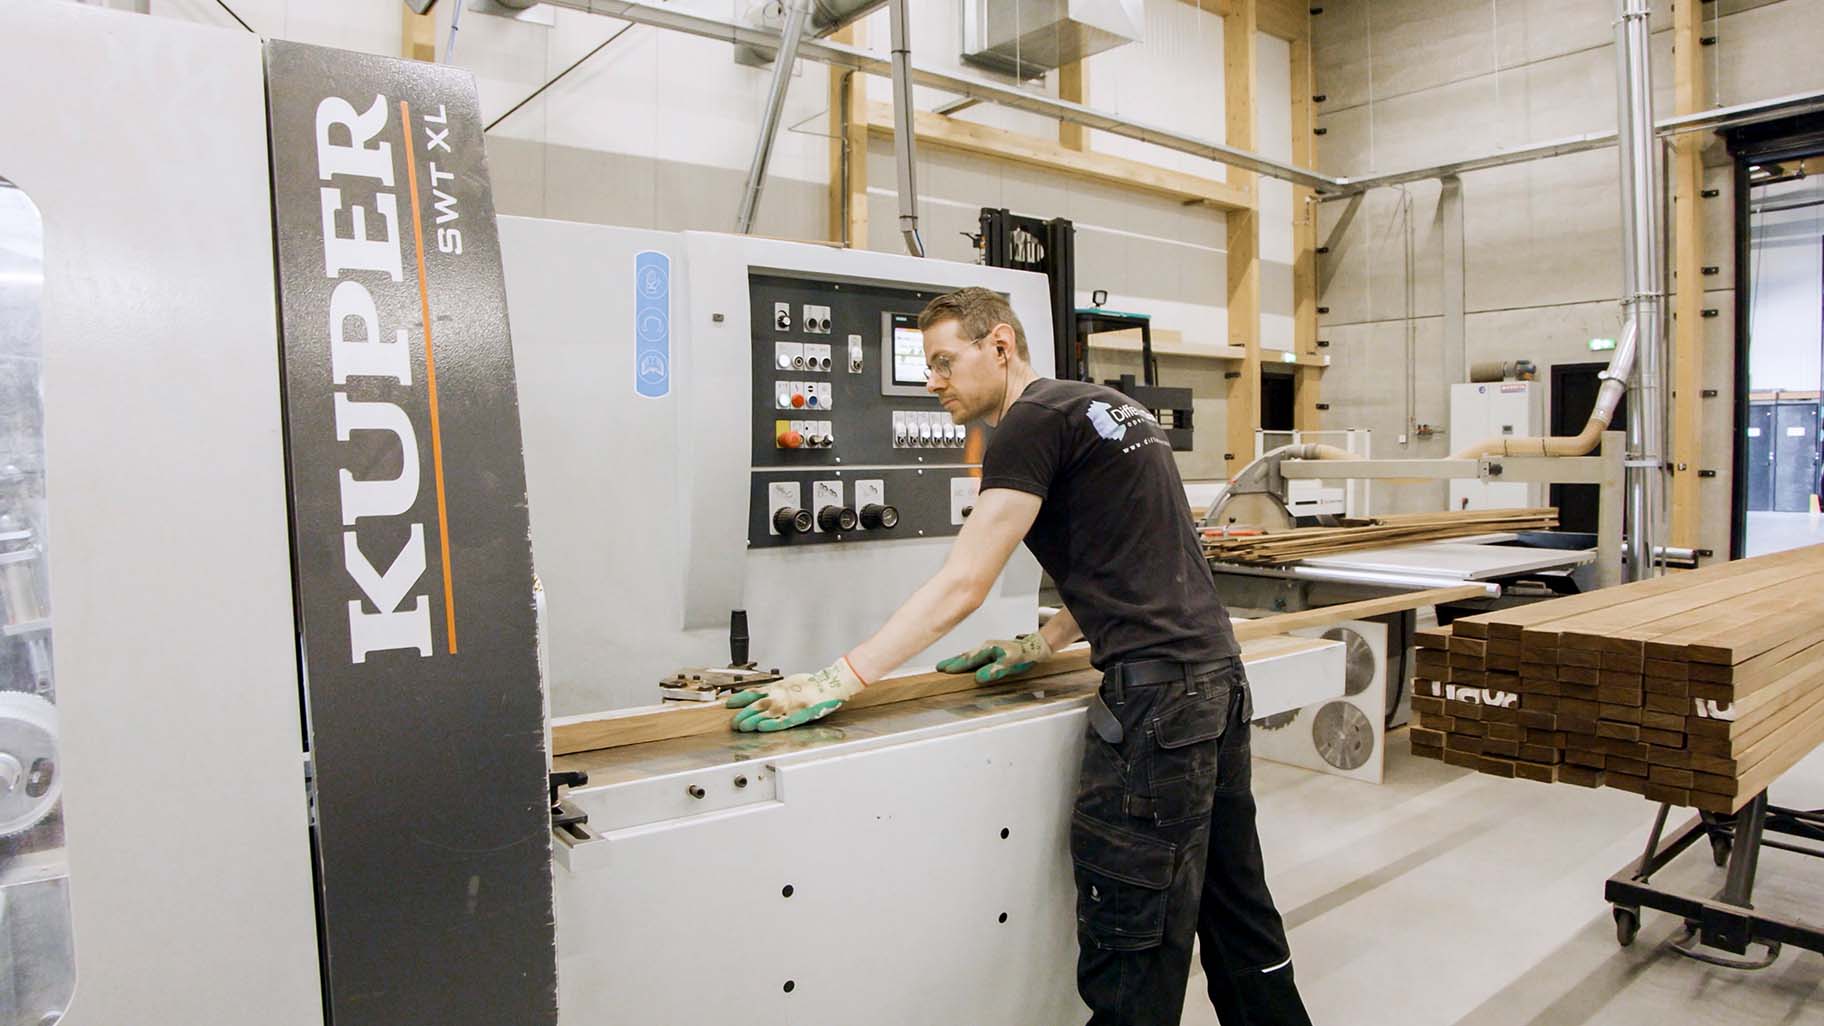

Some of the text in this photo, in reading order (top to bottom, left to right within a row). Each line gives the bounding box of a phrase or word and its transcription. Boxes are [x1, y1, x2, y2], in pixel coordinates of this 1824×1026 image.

[424, 104, 463, 256] SWT XL
[315, 93, 434, 665] KUPER
